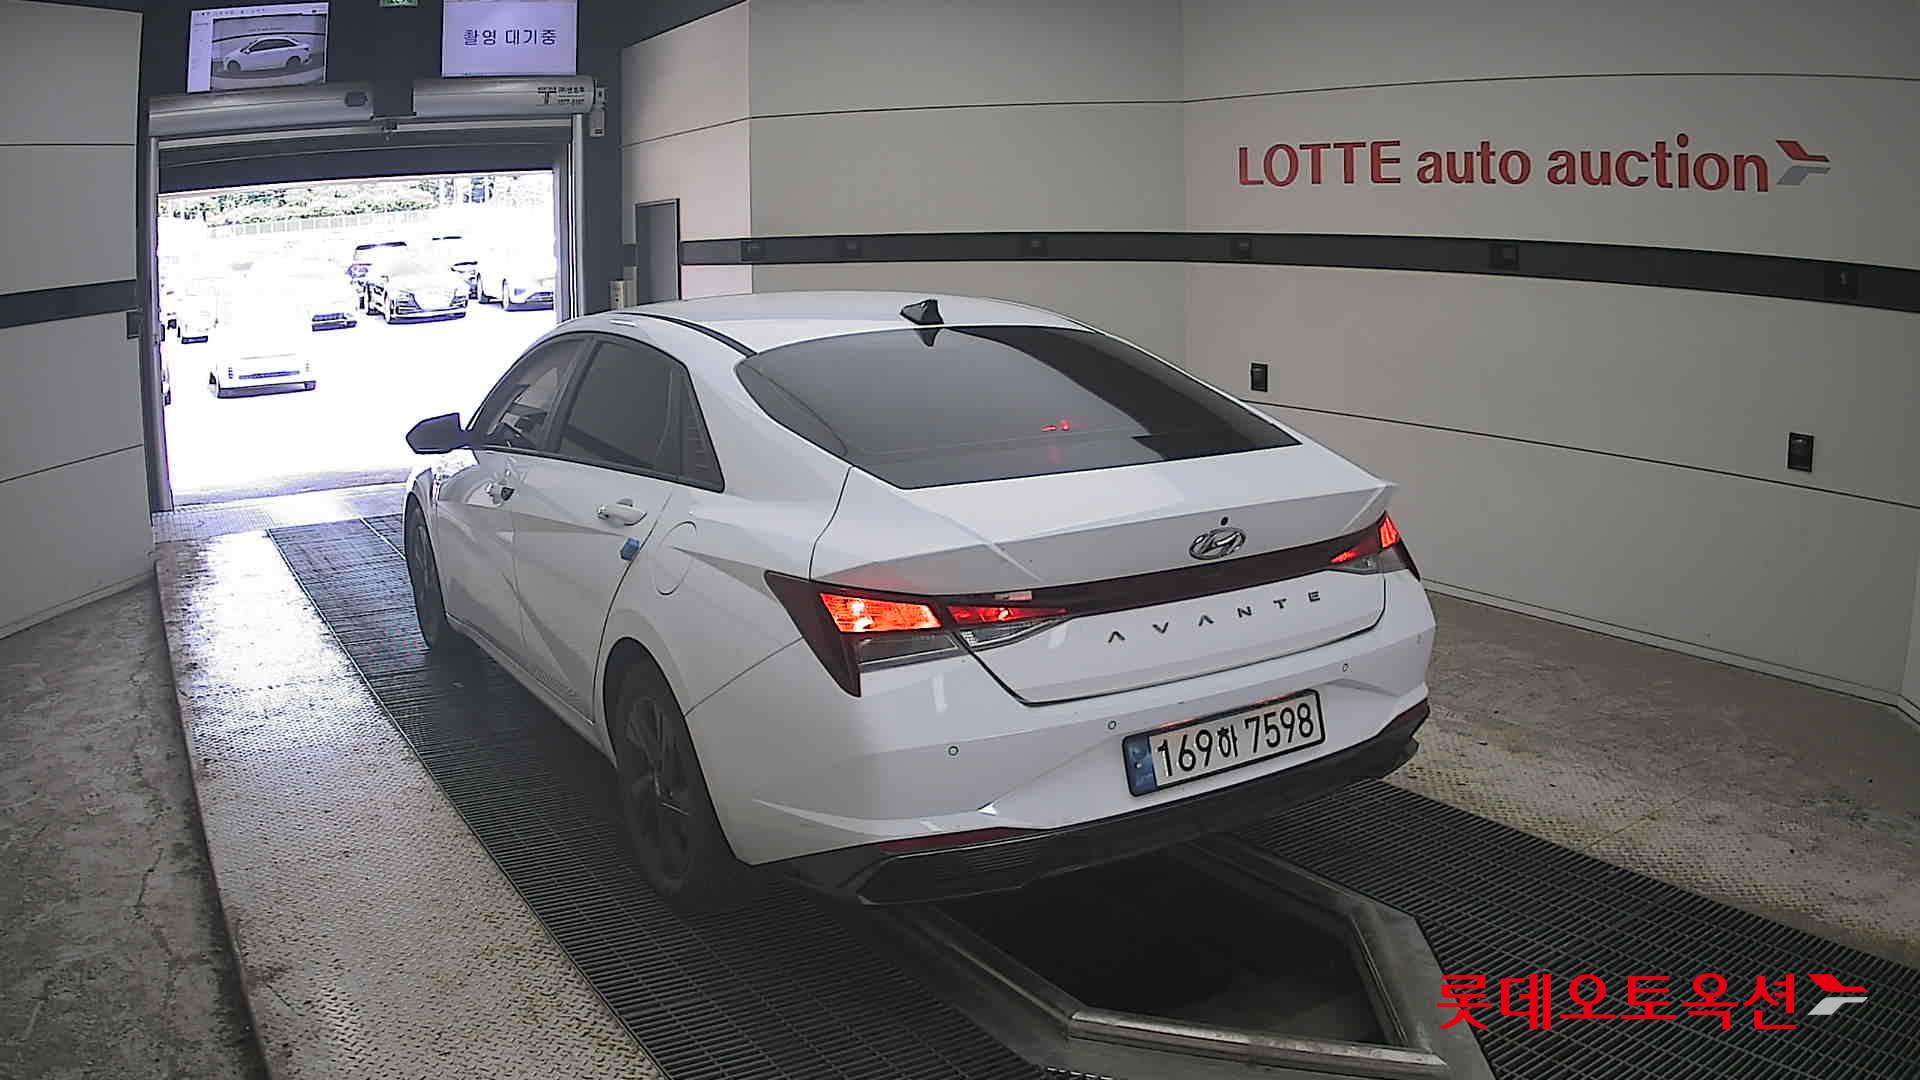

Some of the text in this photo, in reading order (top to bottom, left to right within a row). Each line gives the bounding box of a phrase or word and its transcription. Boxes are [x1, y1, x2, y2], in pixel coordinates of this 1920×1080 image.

[505, 29, 557, 46] 대기중
[1238, 132, 1769, 193] LOTTE auto auction
[1107, 590, 1321, 643] AVANTE
[1156, 702, 1314, 777] 169하 7598
